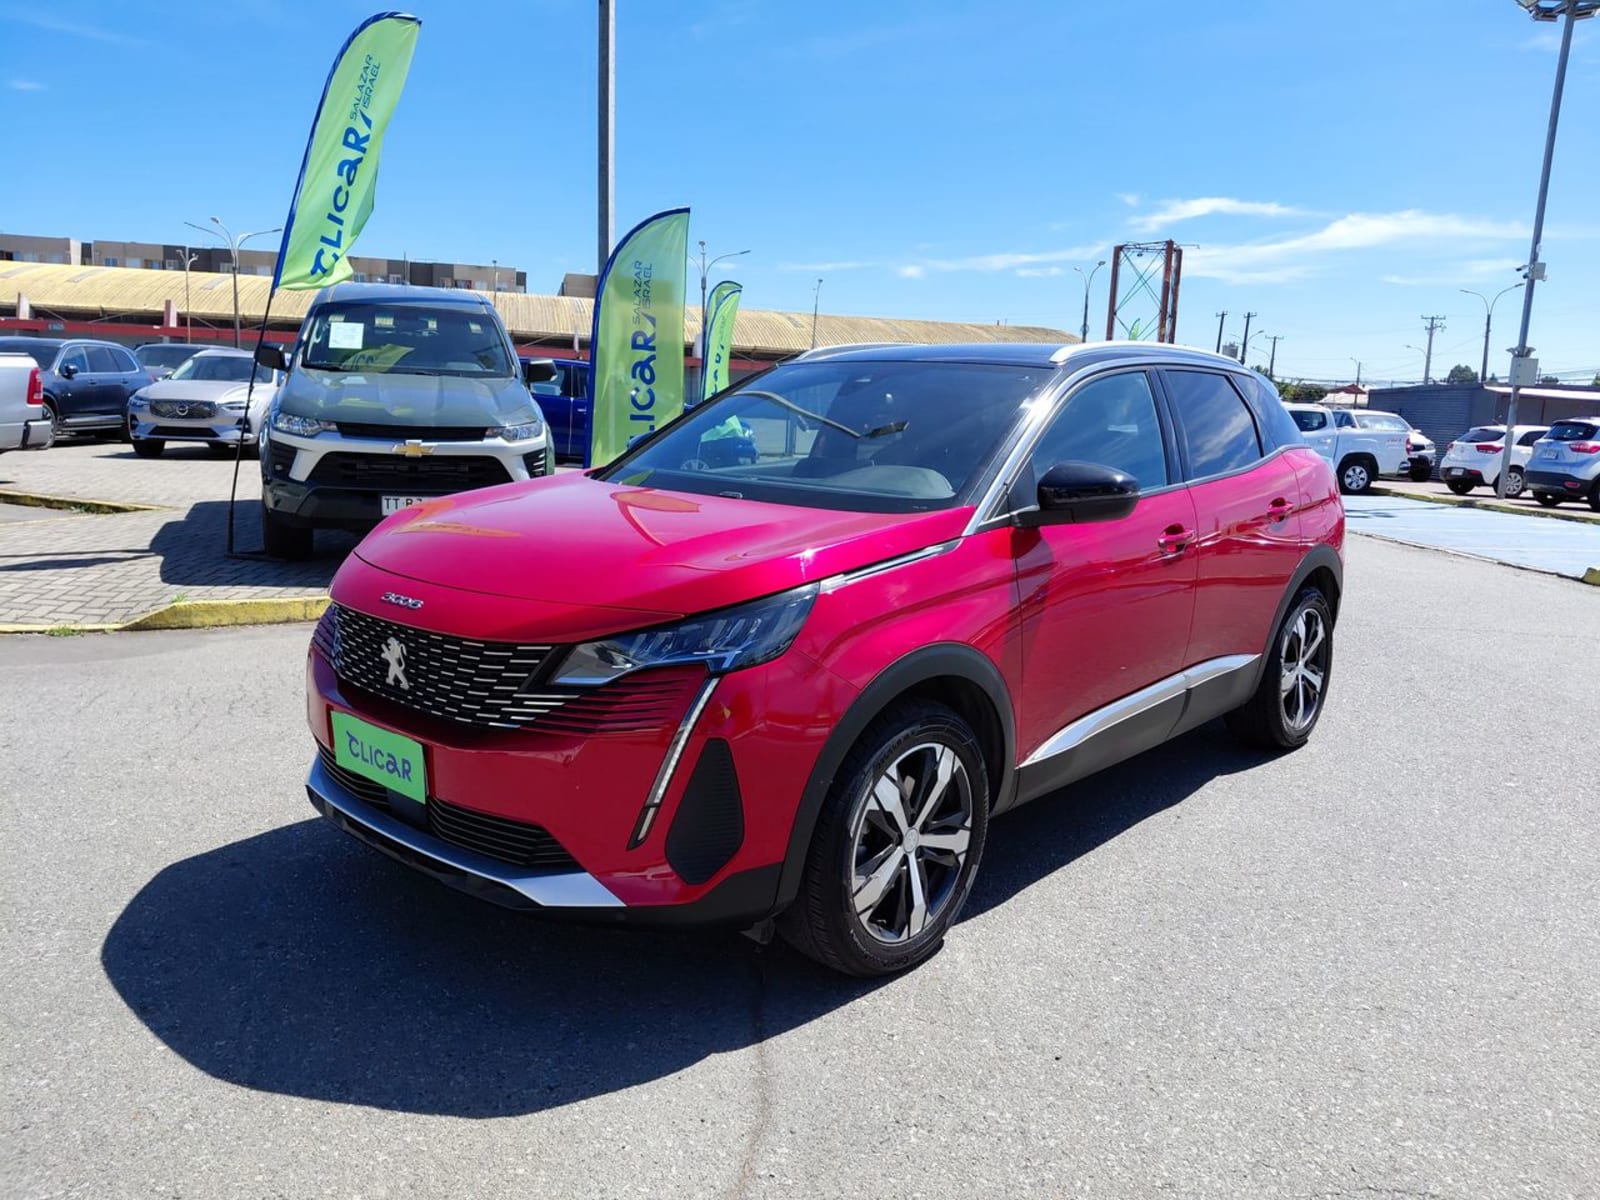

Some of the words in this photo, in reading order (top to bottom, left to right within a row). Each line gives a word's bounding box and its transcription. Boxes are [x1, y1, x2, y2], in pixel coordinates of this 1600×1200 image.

[350, 54, 374, 121] SALAZAR
[362, 62, 381, 110] ISRAEL
[632, 260, 643, 324] SALAZAR
[642, 262, 653, 310] ISRAEL
